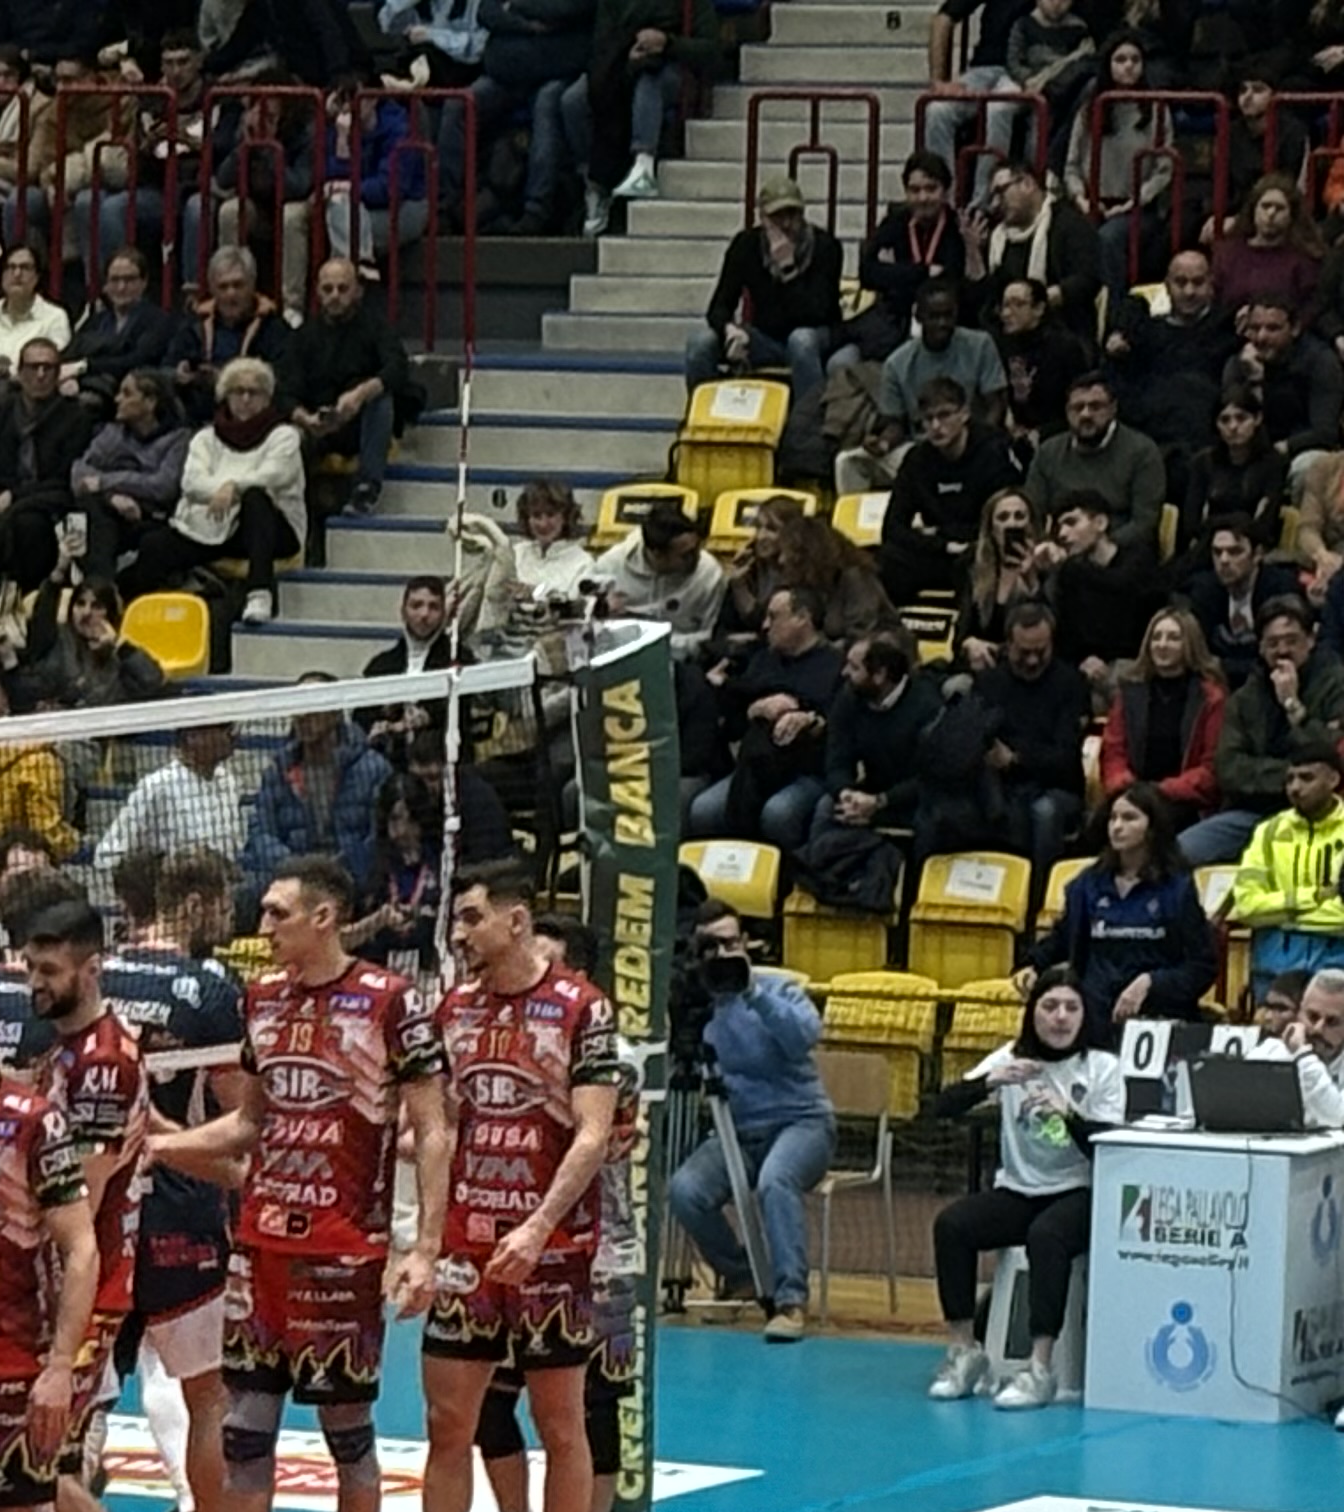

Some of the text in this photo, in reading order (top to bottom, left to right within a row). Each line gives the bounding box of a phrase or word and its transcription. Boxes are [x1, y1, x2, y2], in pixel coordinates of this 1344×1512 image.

[603, 680, 655, 847] BANCA
[614, 874, 654, 1045] REDEM
[1134, 1031, 1154, 1070] 0
[272, 1066, 320, 1099] SIR
[475, 1074, 517, 1105] SIR
[1230, 1232, 1248, 1249] A
